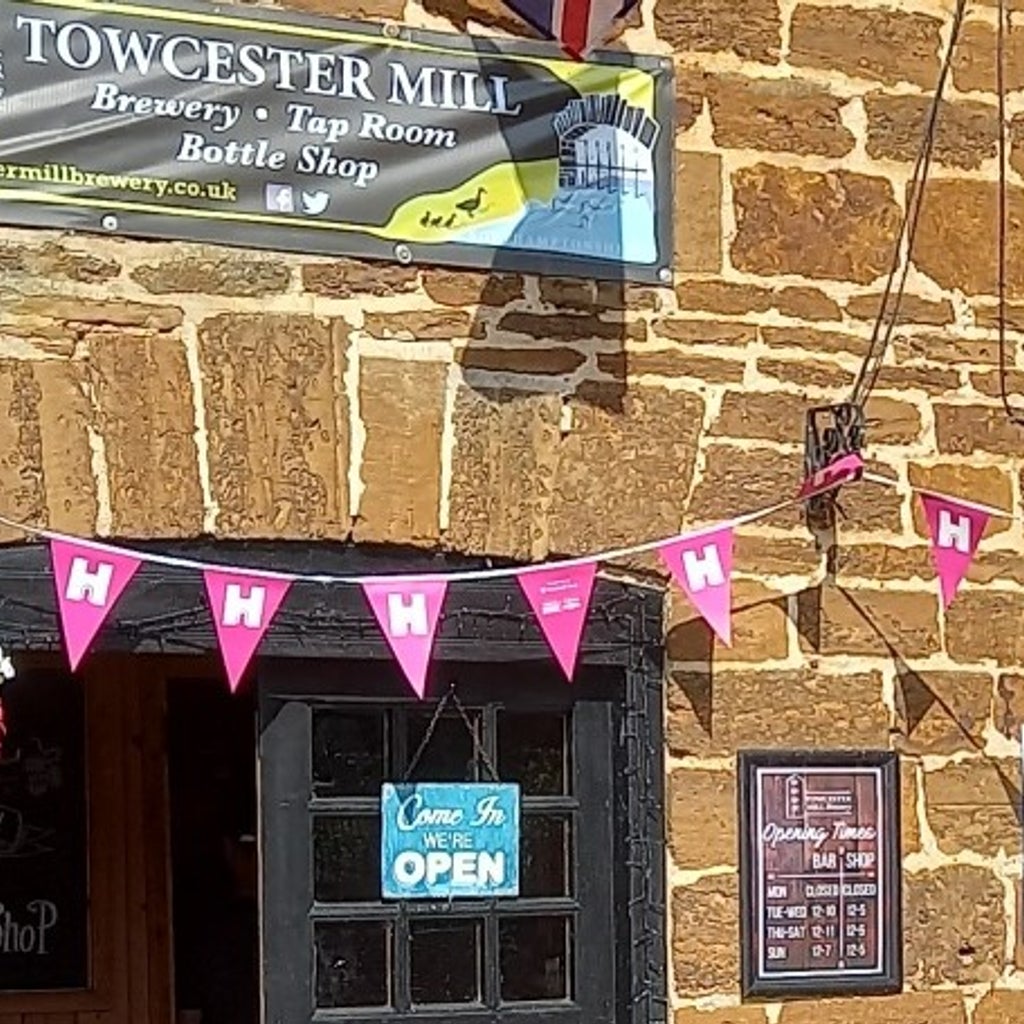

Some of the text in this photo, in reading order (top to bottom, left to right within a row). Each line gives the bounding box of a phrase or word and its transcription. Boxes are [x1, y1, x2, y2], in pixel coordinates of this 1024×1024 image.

[16, 15, 523, 117] TOWCESTER MILL
[91, 82, 458, 149] Brewery Tap Room
[176, 132, 380, 188] Bottle Shop
[397, 793, 507, 830] Come In
[423, 831, 473, 848] WE'RE
[763, 820, 877, 849] Opening Times
[393, 850, 506, 888] OPEN
[812, 851, 875, 869] BAR SHOP
[767, 883, 877, 899] MON CLOSED CLOSED
[767, 946, 787, 959] SUN
